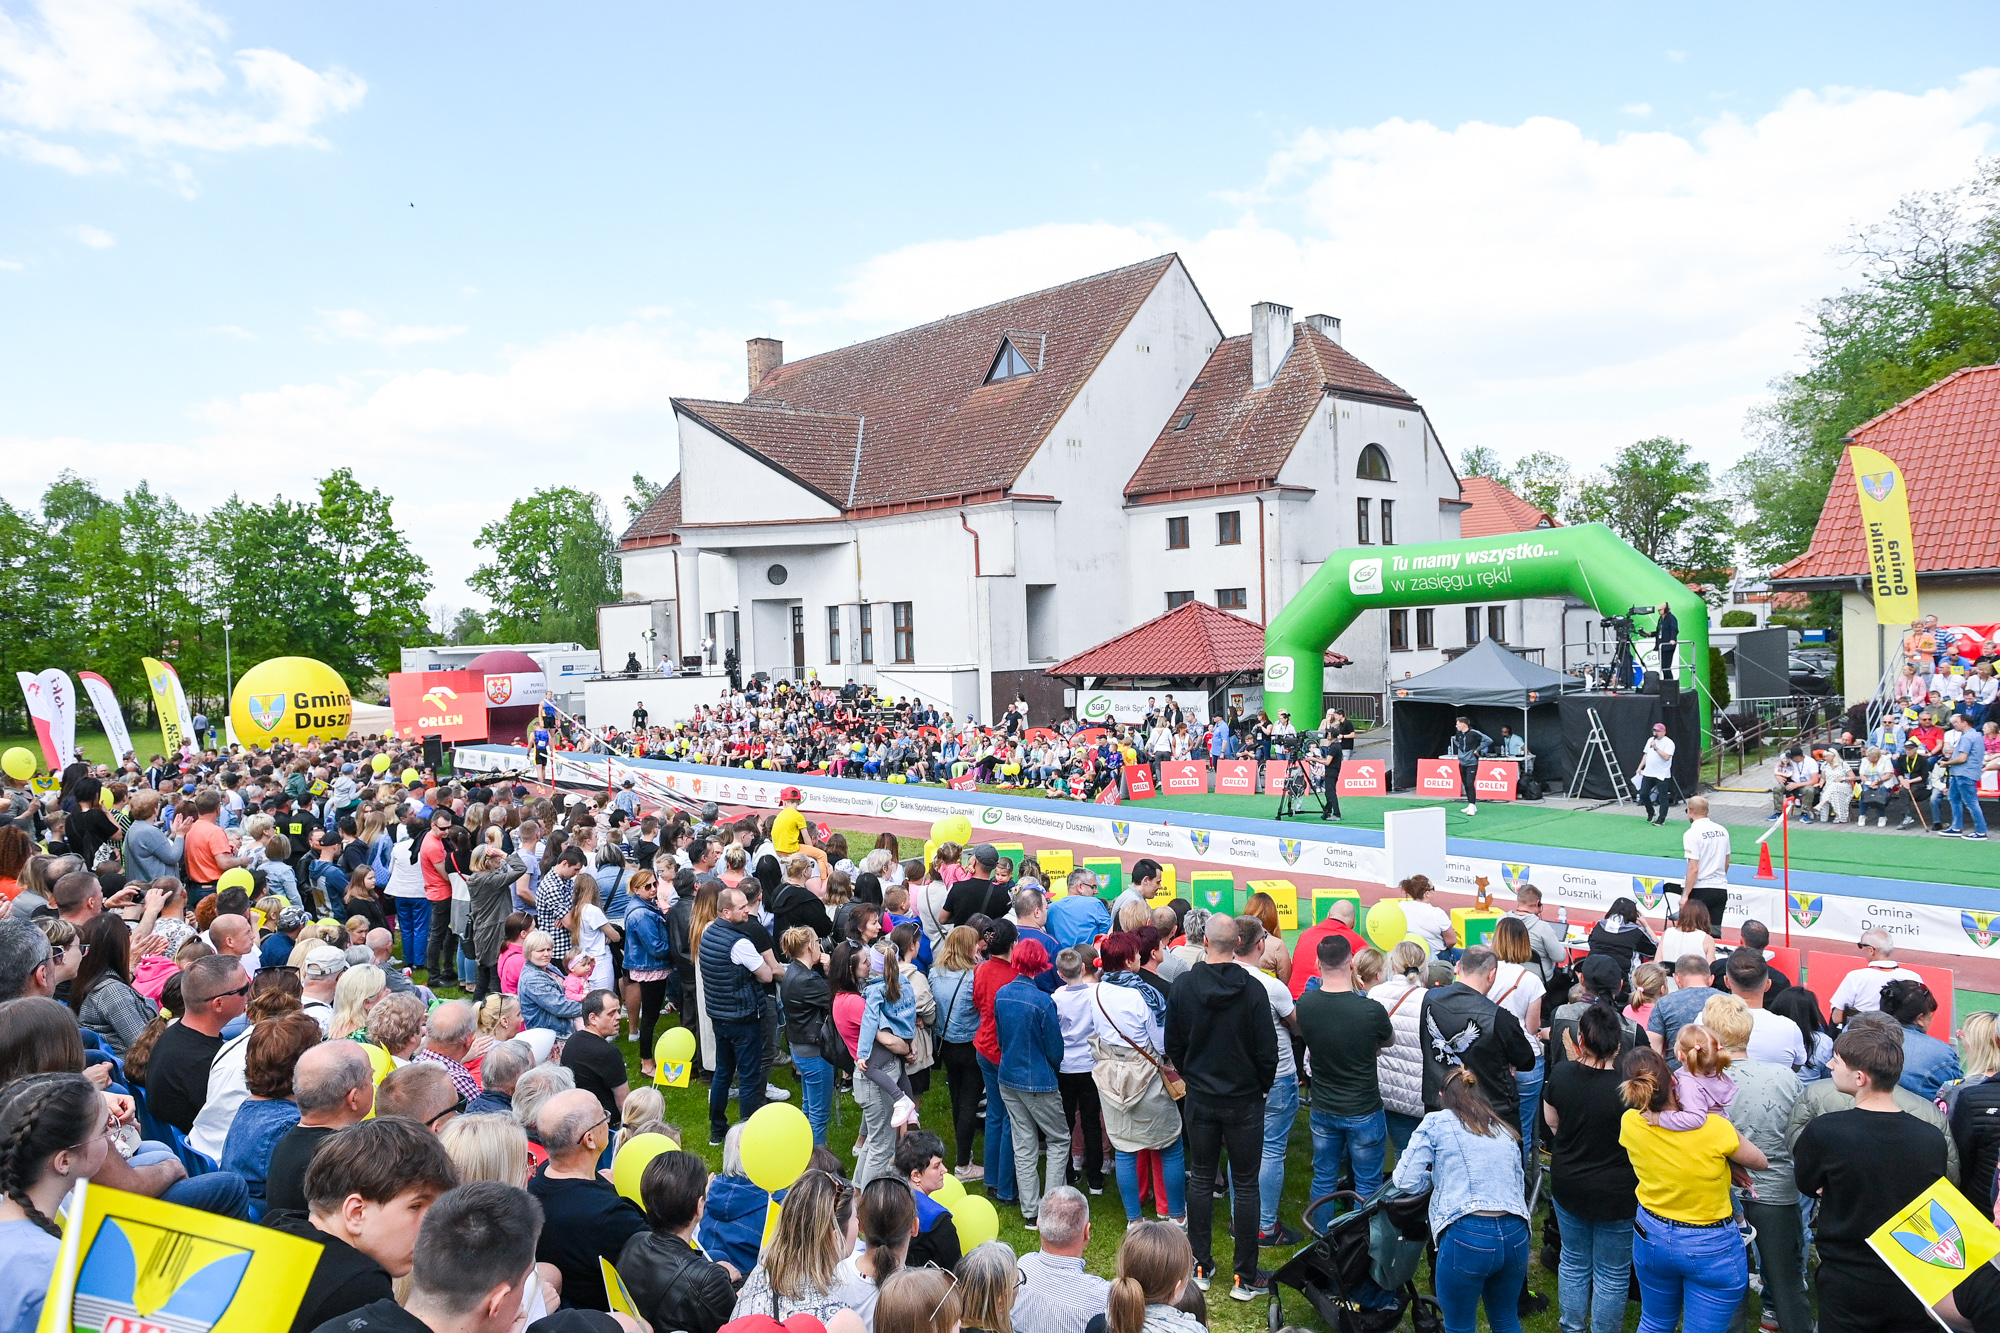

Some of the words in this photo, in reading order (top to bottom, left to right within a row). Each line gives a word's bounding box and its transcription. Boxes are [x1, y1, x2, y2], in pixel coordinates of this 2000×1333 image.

[1391, 555, 1409, 571] Tu
[1412, 552, 1461, 570] mamy
[1465, 542, 1559, 565] wszystko...
[1359, 570, 1371, 578] SGB
[1391, 579, 1406, 592] w
[1410, 572, 1473, 592] zasięgu
[1477, 566, 1513, 588] ręki!
[1356, 583, 1377, 591] MOBILE
[1646, 654, 1660, 662] SG
[294, 691, 351, 709] Gmina
[1091, 703, 1105, 711] SGB
[1115, 704, 1132, 712] Bank
[295, 712, 351, 729] Duszn
[418, 714, 464, 728] ORLEN
[1133, 782, 1149, 791] ORLEN
[1223, 778, 1247, 786] ORLEN
[900, 801, 915, 809] Bank
[950, 806, 975, 816] Duszniki
[1006, 813, 1023, 823] Bank
[1023, 814, 1064, 830] Spółdzielczy
[1066, 821, 1095, 834] Duszniki
[1149, 829, 1170, 837] Gmina
[1147, 838, 1174, 849] Duszniki
[1232, 837, 1256, 847] Gmina
[1230, 848, 1260, 858] Duszniki
[1326, 846, 1353, 857] Gmina
[1324, 858, 1357, 869] Duszniki
[1562, 873, 1597, 886] Gmina
[1558, 887, 1602, 900] Duszniki
[1724, 905, 1749, 916] zniki
[1867, 904, 1913, 919] Gmina
